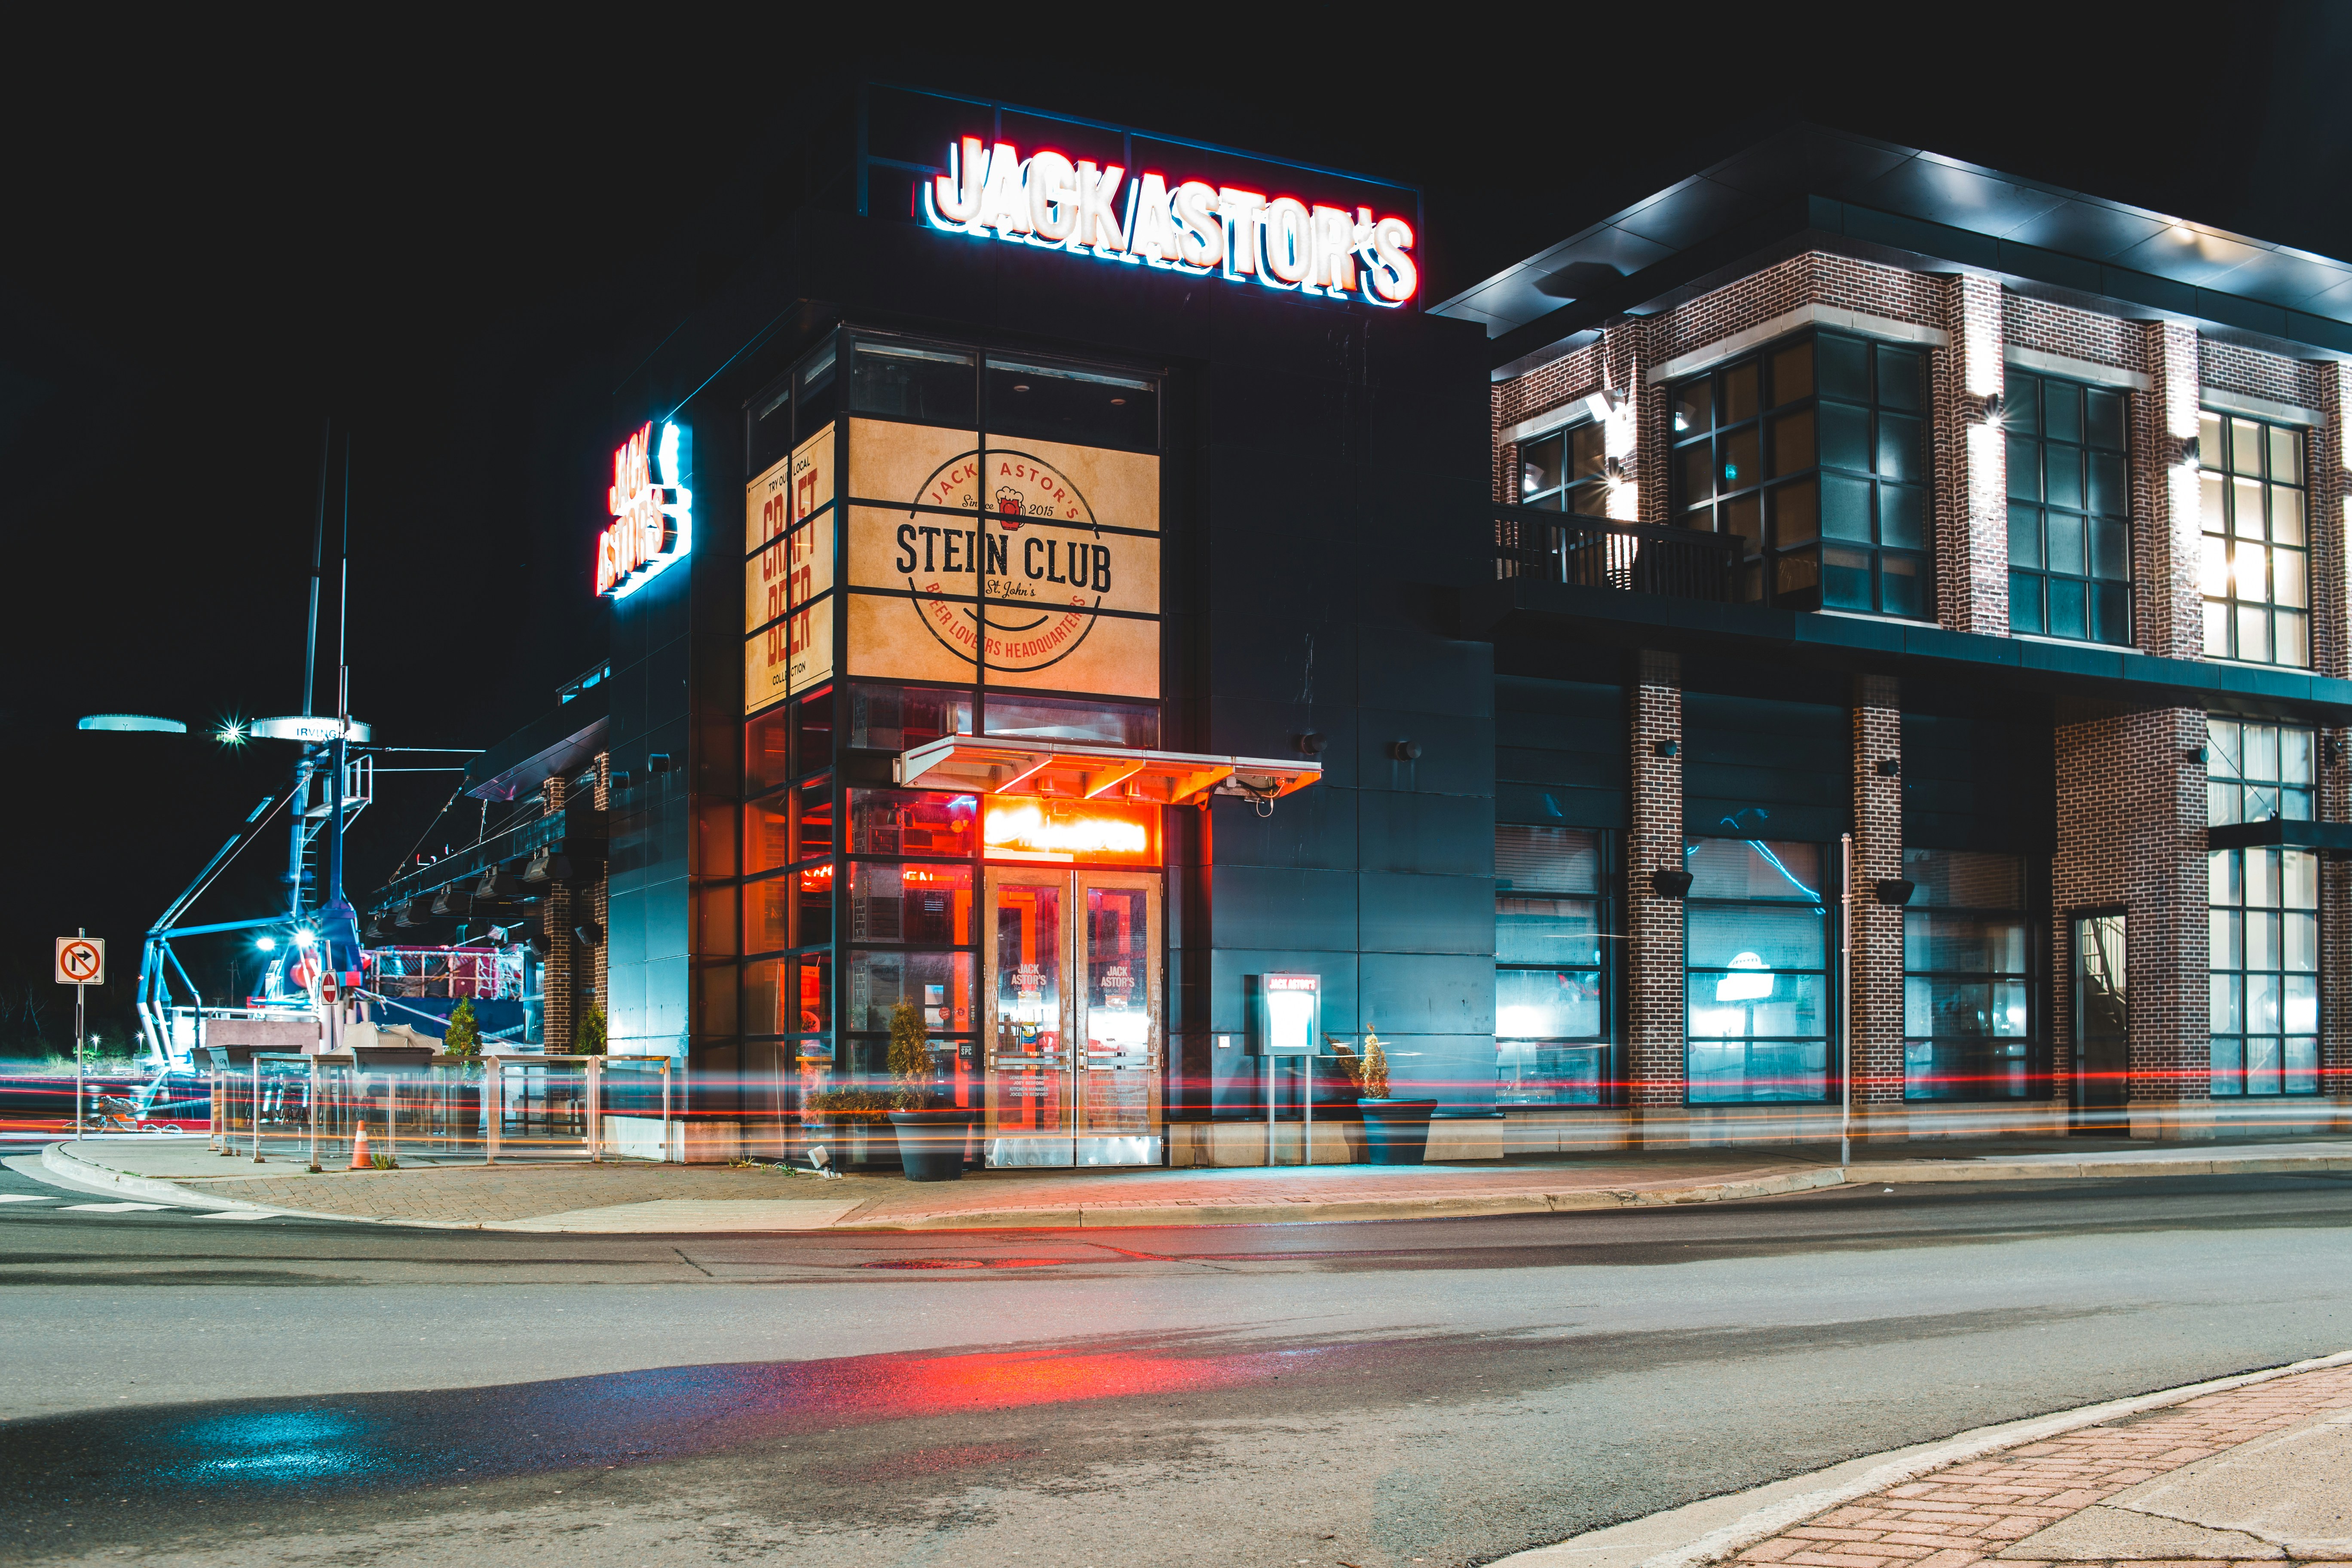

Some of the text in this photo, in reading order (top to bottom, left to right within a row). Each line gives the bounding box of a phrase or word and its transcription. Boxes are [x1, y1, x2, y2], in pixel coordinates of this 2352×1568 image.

[935, 135, 1418, 302] JACK ASTOR'S
[609, 420, 652, 516] JACK
[769, 456, 810, 493] TRY OU LOCAL
[931, 462, 1078, 519] JACK ASTOR'S
[962, 494, 1054, 516] Since 2015
[596, 487, 665, 597] ASTOR'S
[763, 467, 818, 582] CRAFT
[896, 524, 1112, 594] STEIN CLUB
[985, 579, 1036, 598] St. John's
[768, 564, 811, 667] BEER
[949, 620, 1001, 656] LOVERS
[1005, 595, 1086, 658] HEADQUARTERS
[297, 728, 336, 738] IRVING
[1011, 974, 1047, 986] ASTOR'S
[1017, 964, 1039, 974] JACK
[1101, 976, 1135, 987] ASTOR'S
[1107, 966, 1128, 977] JACK
[1269, 979, 1287, 989] JACK
